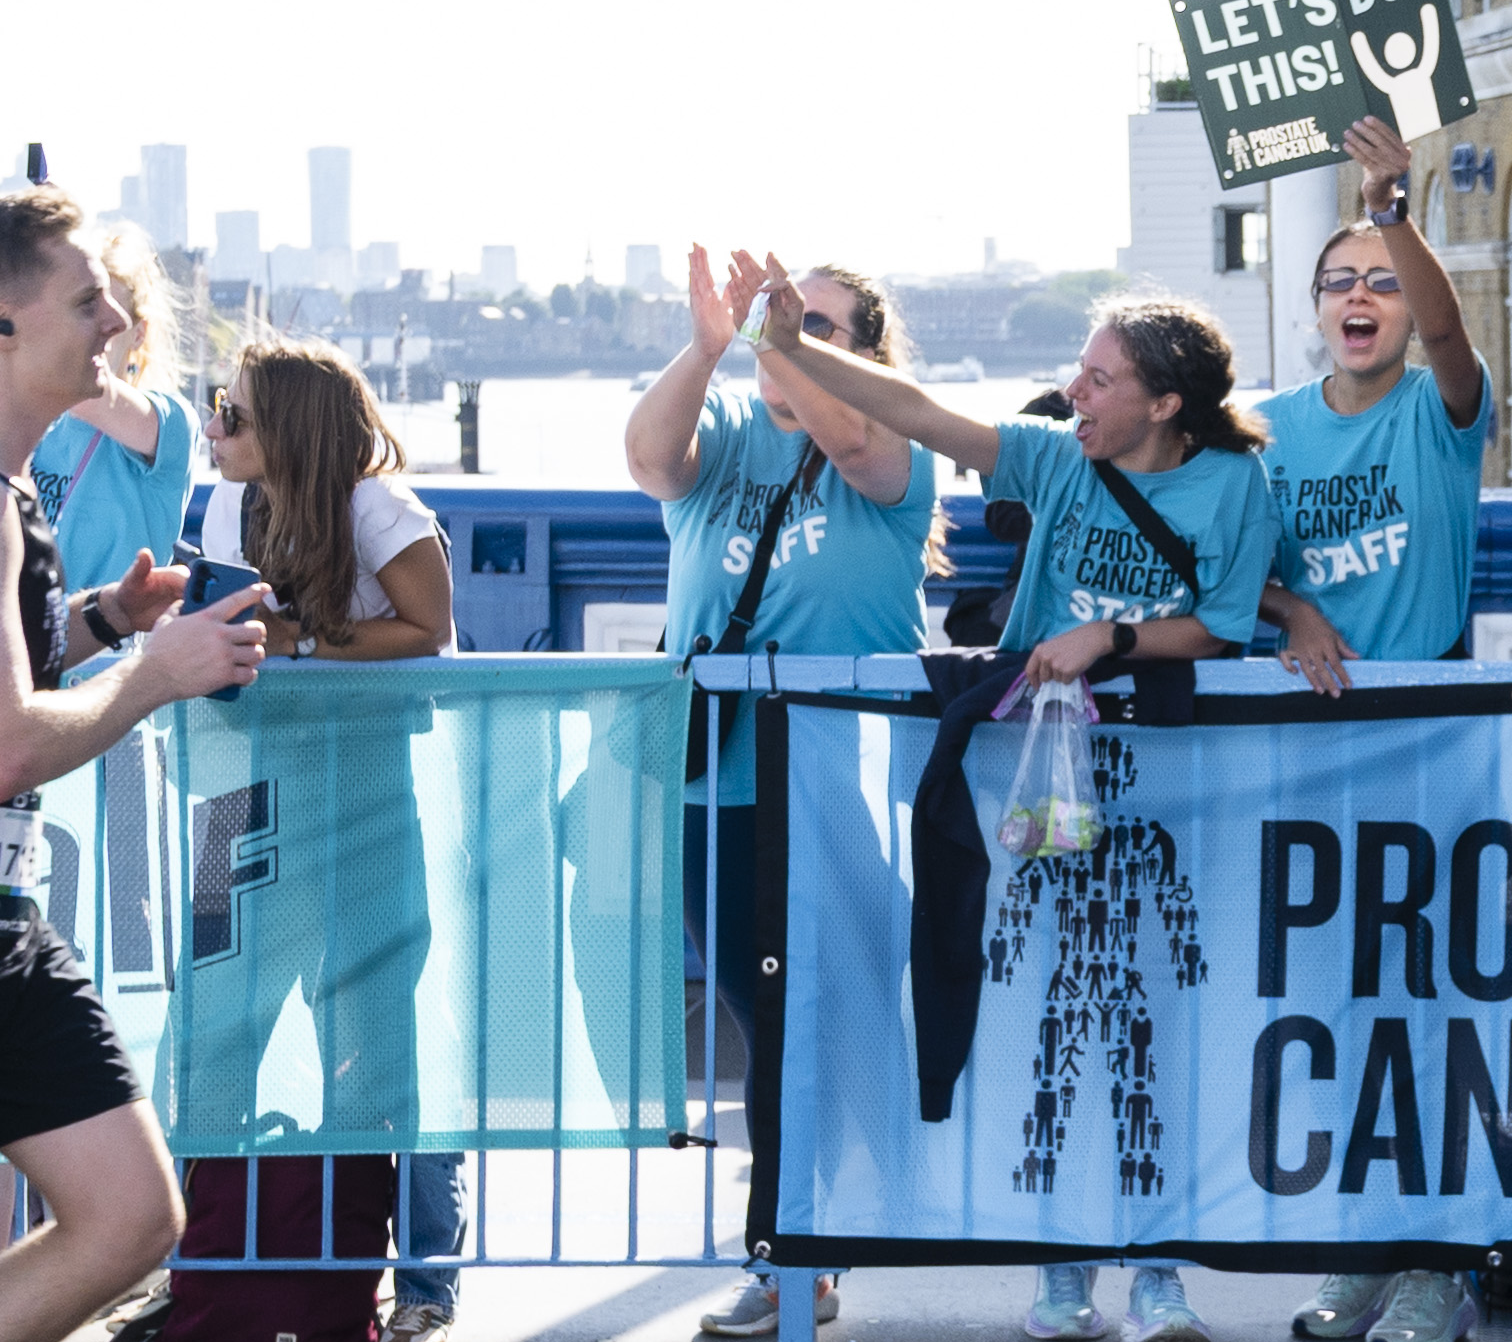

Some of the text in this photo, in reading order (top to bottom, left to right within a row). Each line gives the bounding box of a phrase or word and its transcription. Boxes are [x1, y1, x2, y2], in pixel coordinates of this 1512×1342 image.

[1206, 40, 1344, 112] THIS!
[1248, 116, 1319, 150] PROSTATE
[1253, 132, 1330, 167] CANCER UK
[1303, 522, 1409, 586] STAFF
